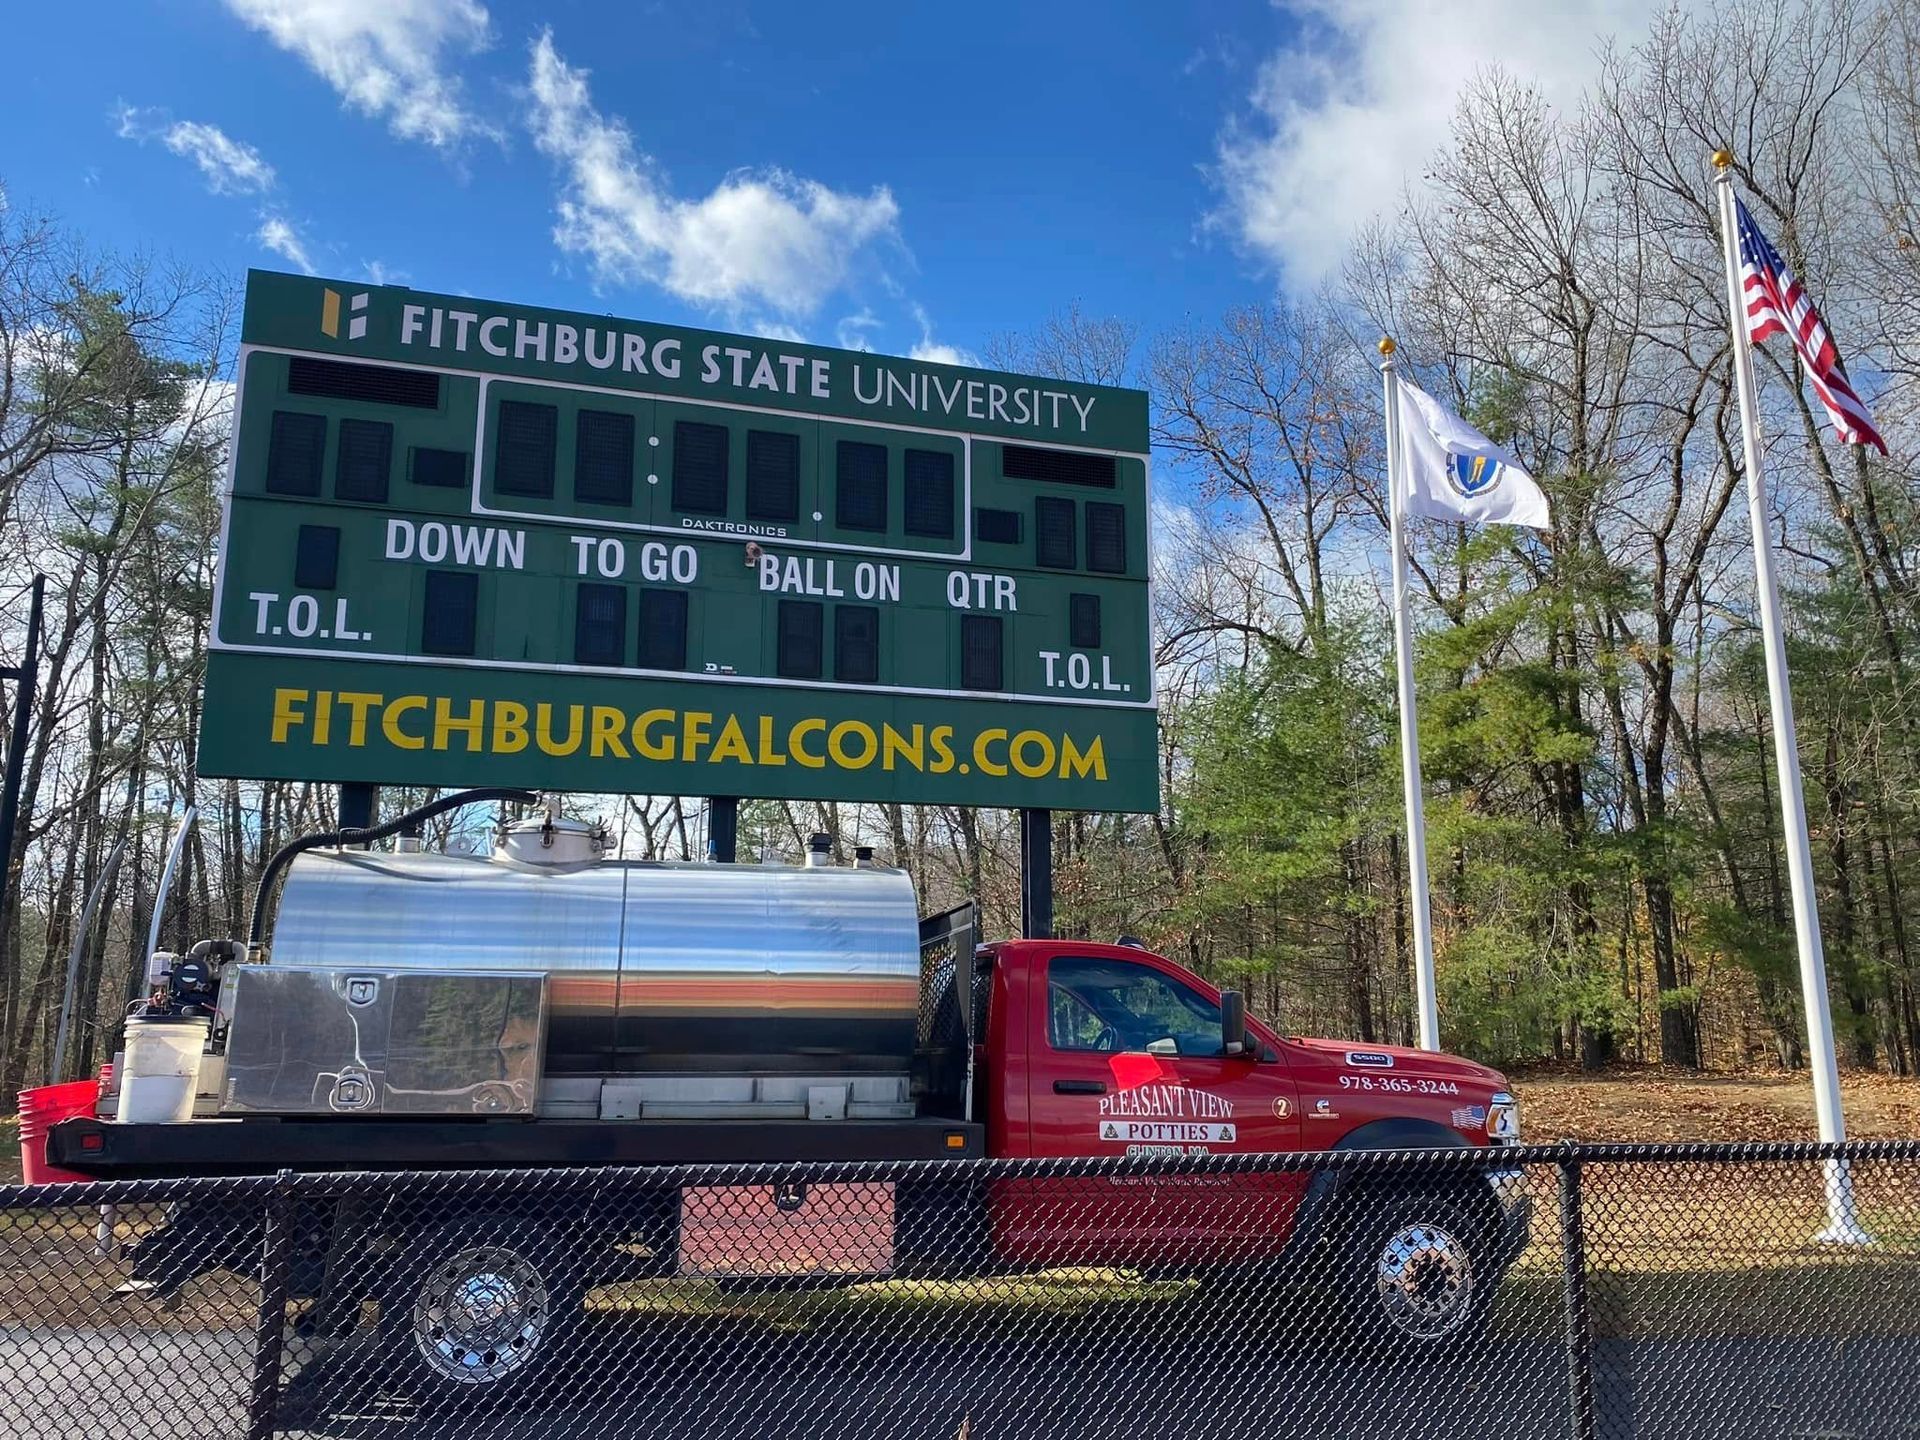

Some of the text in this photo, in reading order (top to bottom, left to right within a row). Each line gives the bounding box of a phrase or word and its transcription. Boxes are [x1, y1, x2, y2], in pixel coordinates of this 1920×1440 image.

[401, 304, 1096, 432] FITCHBURG STATE UNIVERSITY
[386, 519, 525, 569] DOWN
[682, 518, 787, 537] DAKTRONICS
[570, 536, 697, 584] TO GO
[759, 553, 900, 602] BALL ON
[947, 570, 1017, 611] QTR
[249, 592, 373, 642] T.O.L.
[1039, 651, 1131, 693] T.O.L.
[270, 687, 1108, 781] FITCHBURGFALCONS.COM
[1099, 1085, 1234, 1118] PLEASANT VIEW
[1338, 1075, 1460, 1096] 978-365-3244
[1277, 1099, 1287, 1117] 2
[1128, 1123, 1209, 1140] POTTIES
